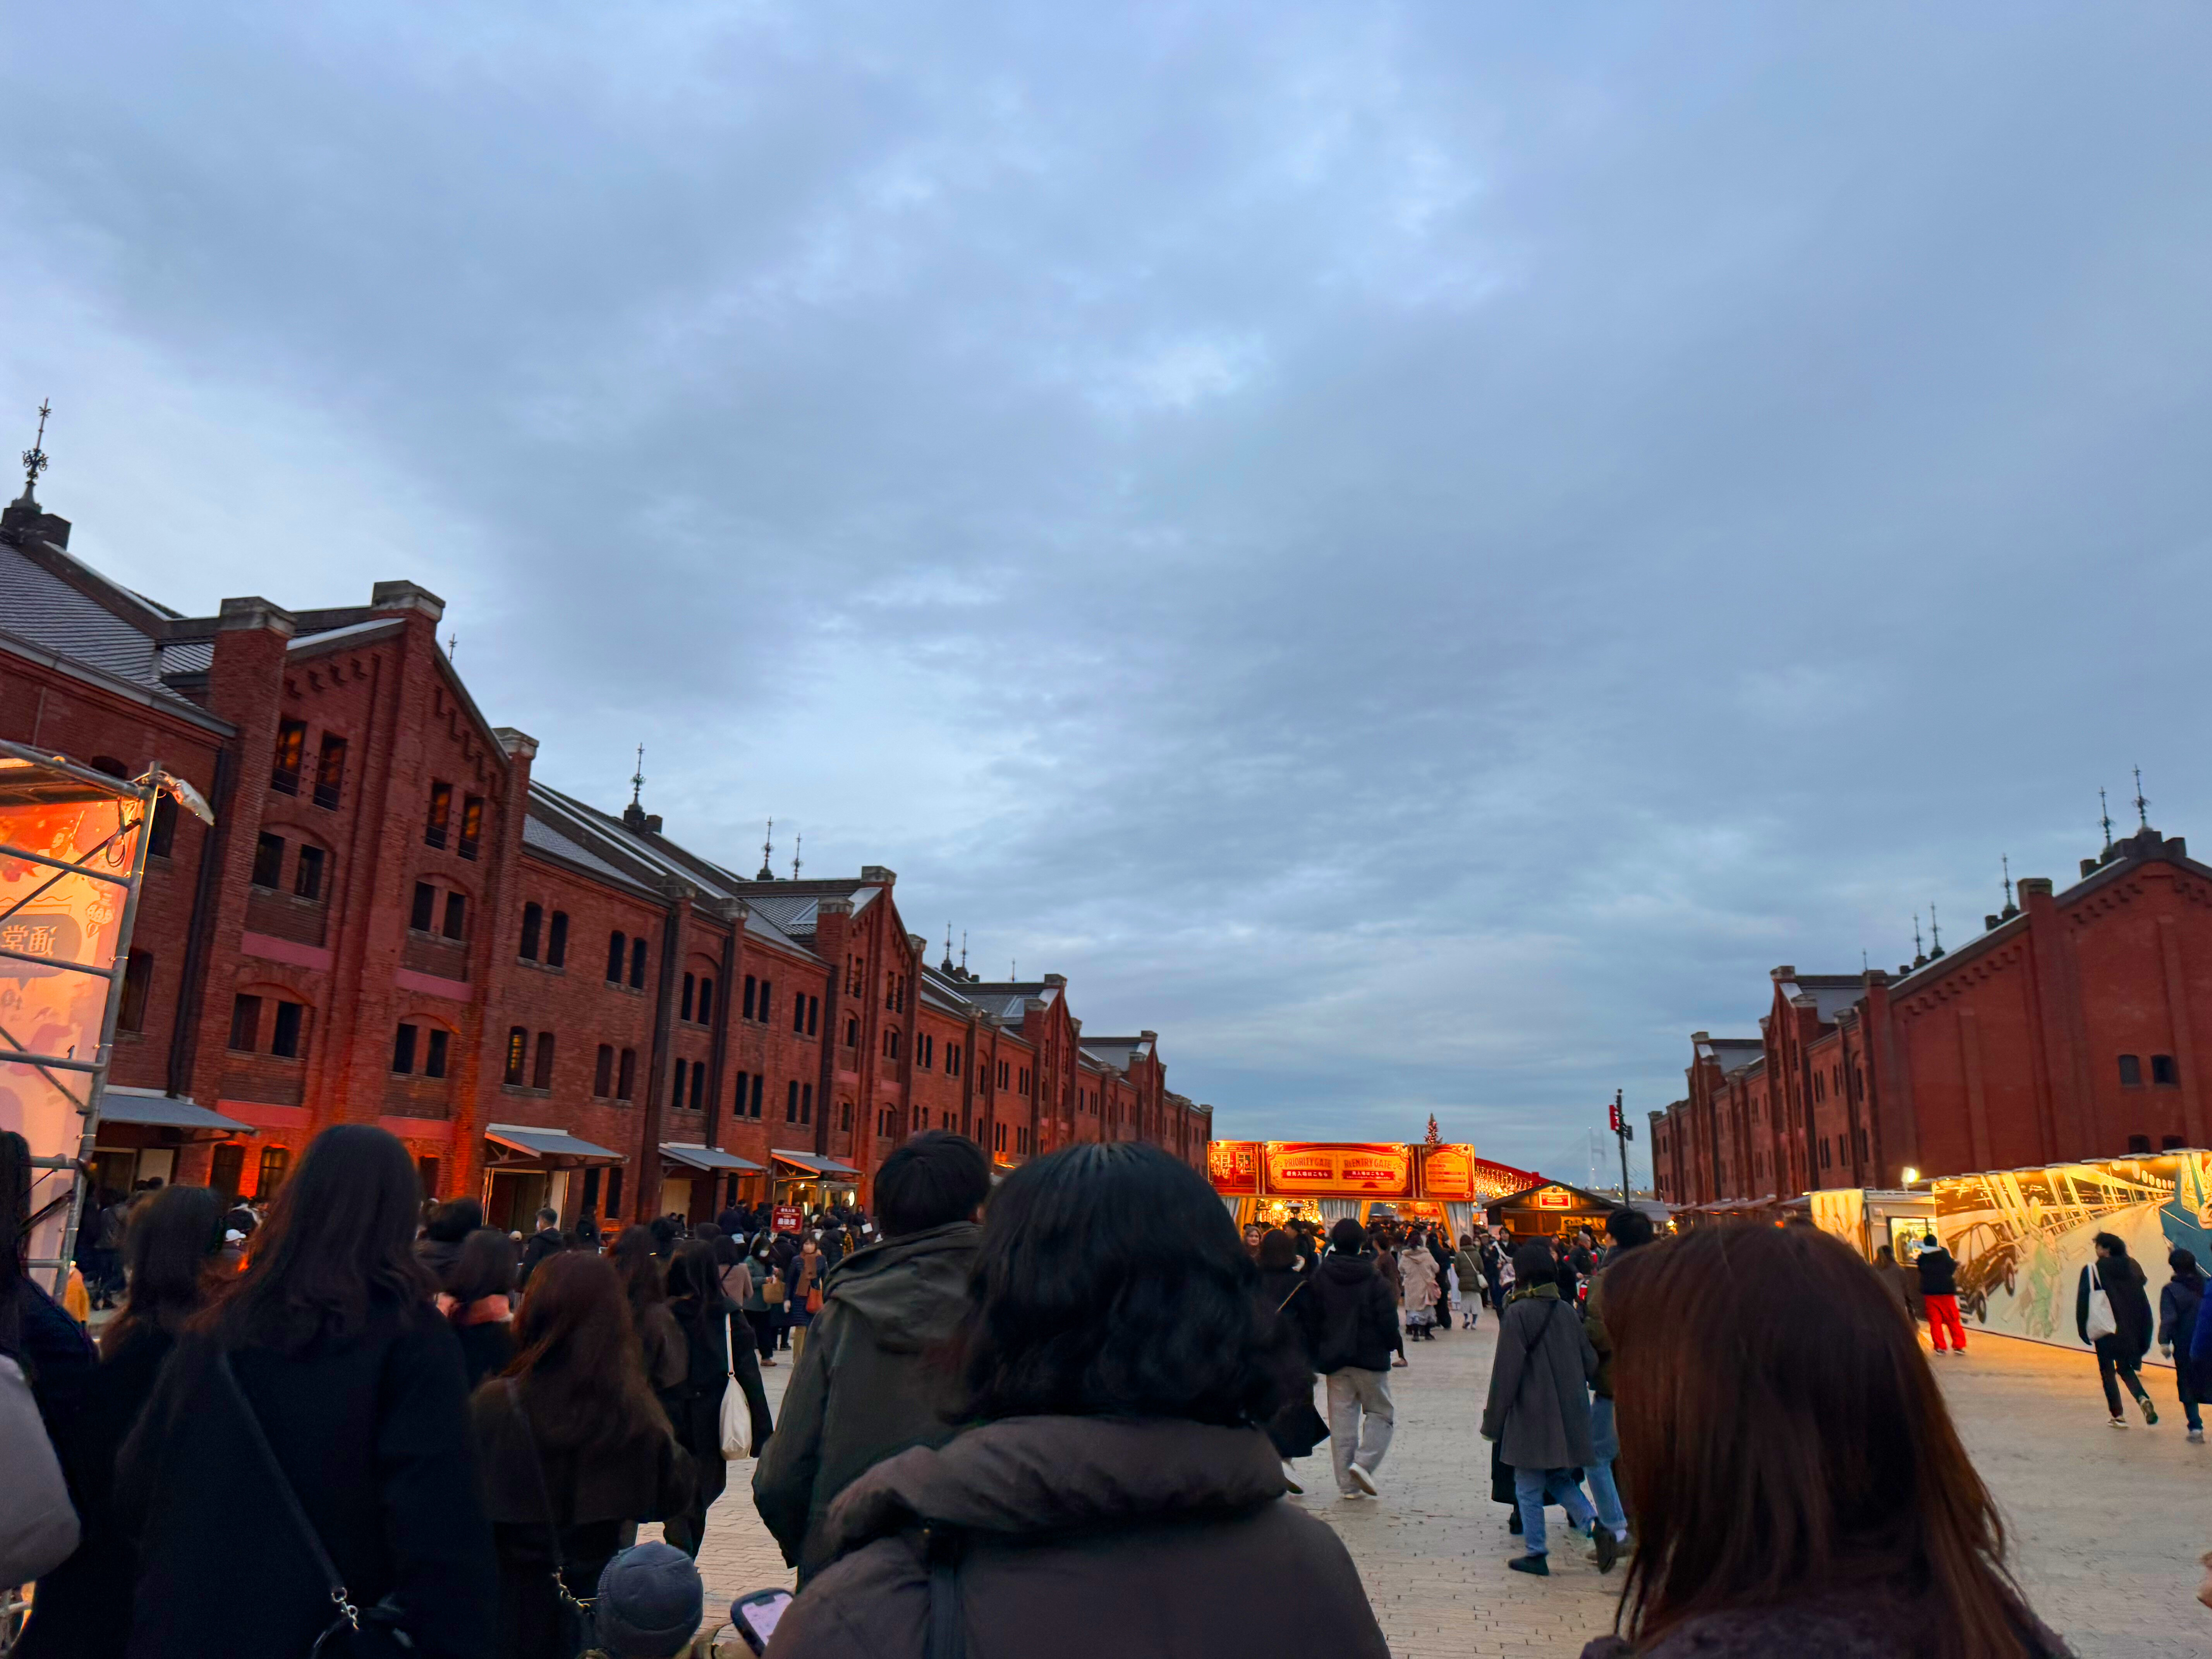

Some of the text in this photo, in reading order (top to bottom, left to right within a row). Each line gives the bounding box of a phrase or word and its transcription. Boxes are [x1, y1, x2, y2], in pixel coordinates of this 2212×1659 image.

[1285, 1157, 1332, 1168] PRIORITY GATE
[1374, 1159, 1392, 1169] GATE
